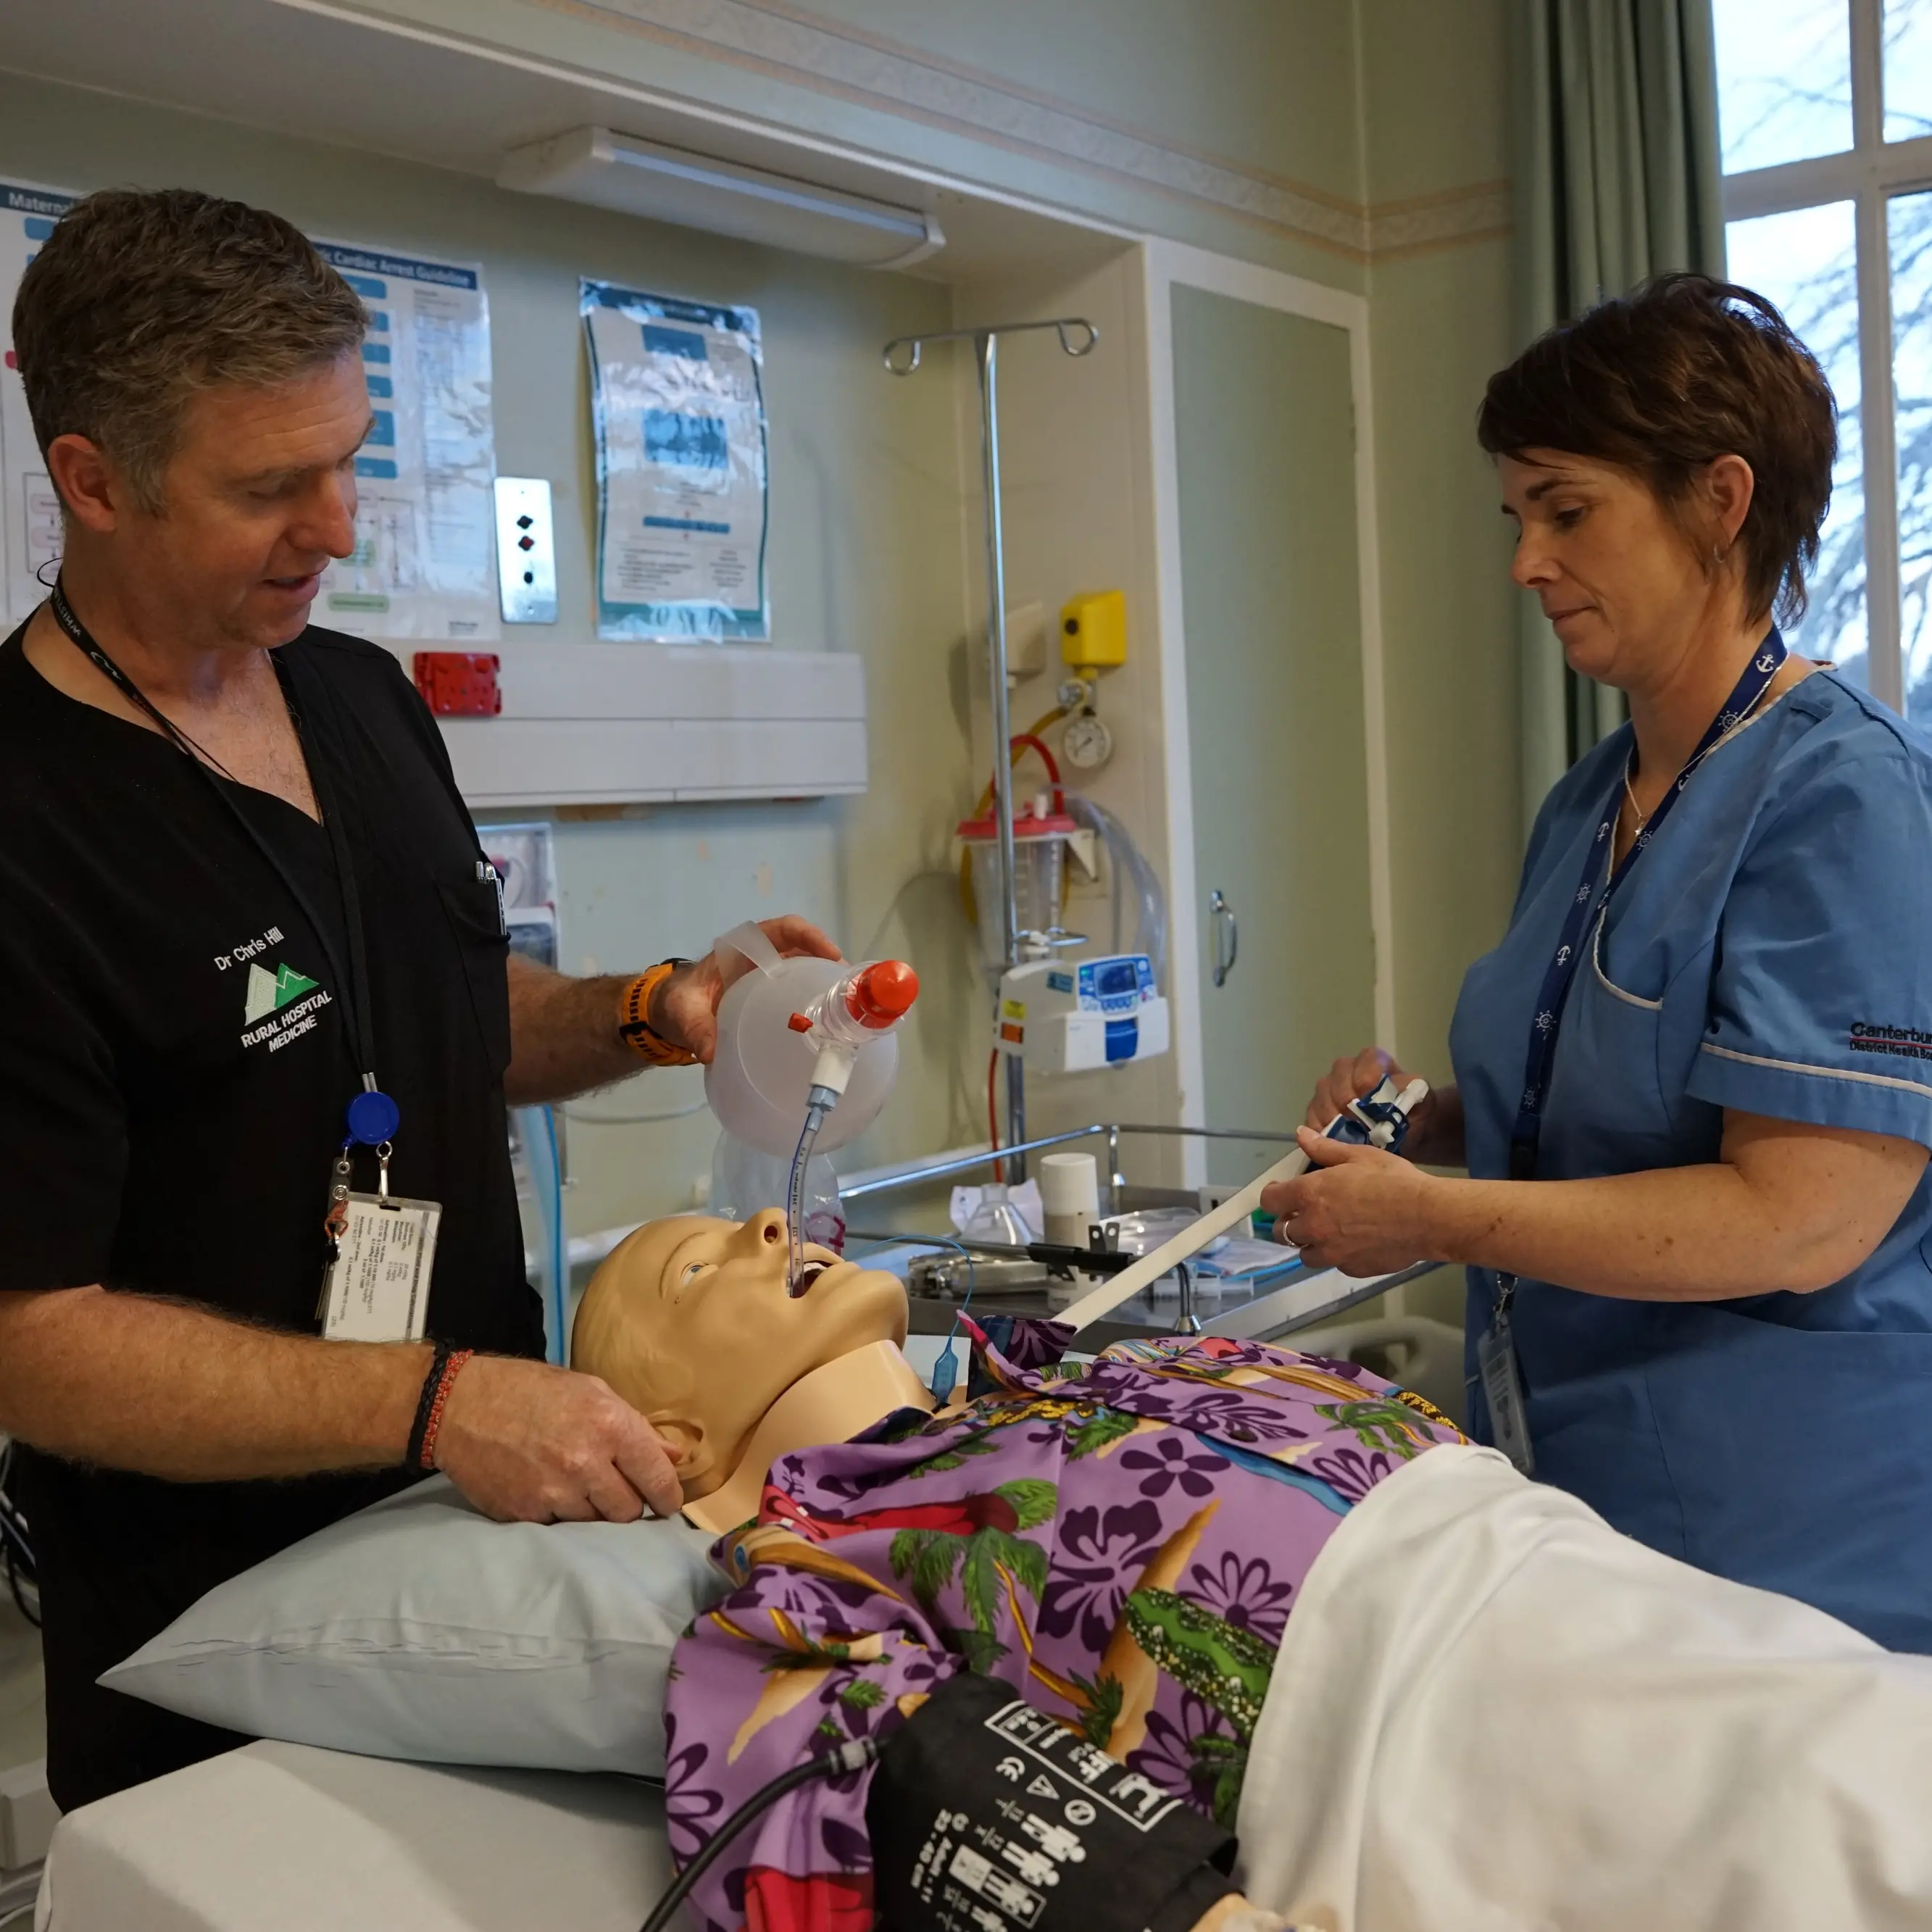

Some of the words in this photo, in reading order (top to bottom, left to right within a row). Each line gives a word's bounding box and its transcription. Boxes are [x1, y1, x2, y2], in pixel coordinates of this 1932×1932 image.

[214, 956, 233, 971] Dr
[233, 938, 267, 962] Chris
[263, 925, 285, 945] Hill
[241, 1020, 282, 1048] RURAL
[280, 990, 333, 1028] HOSPITAL
[268, 1015, 317, 1052] MEDICINE
[1888, 1043, 1920, 1058] Health
